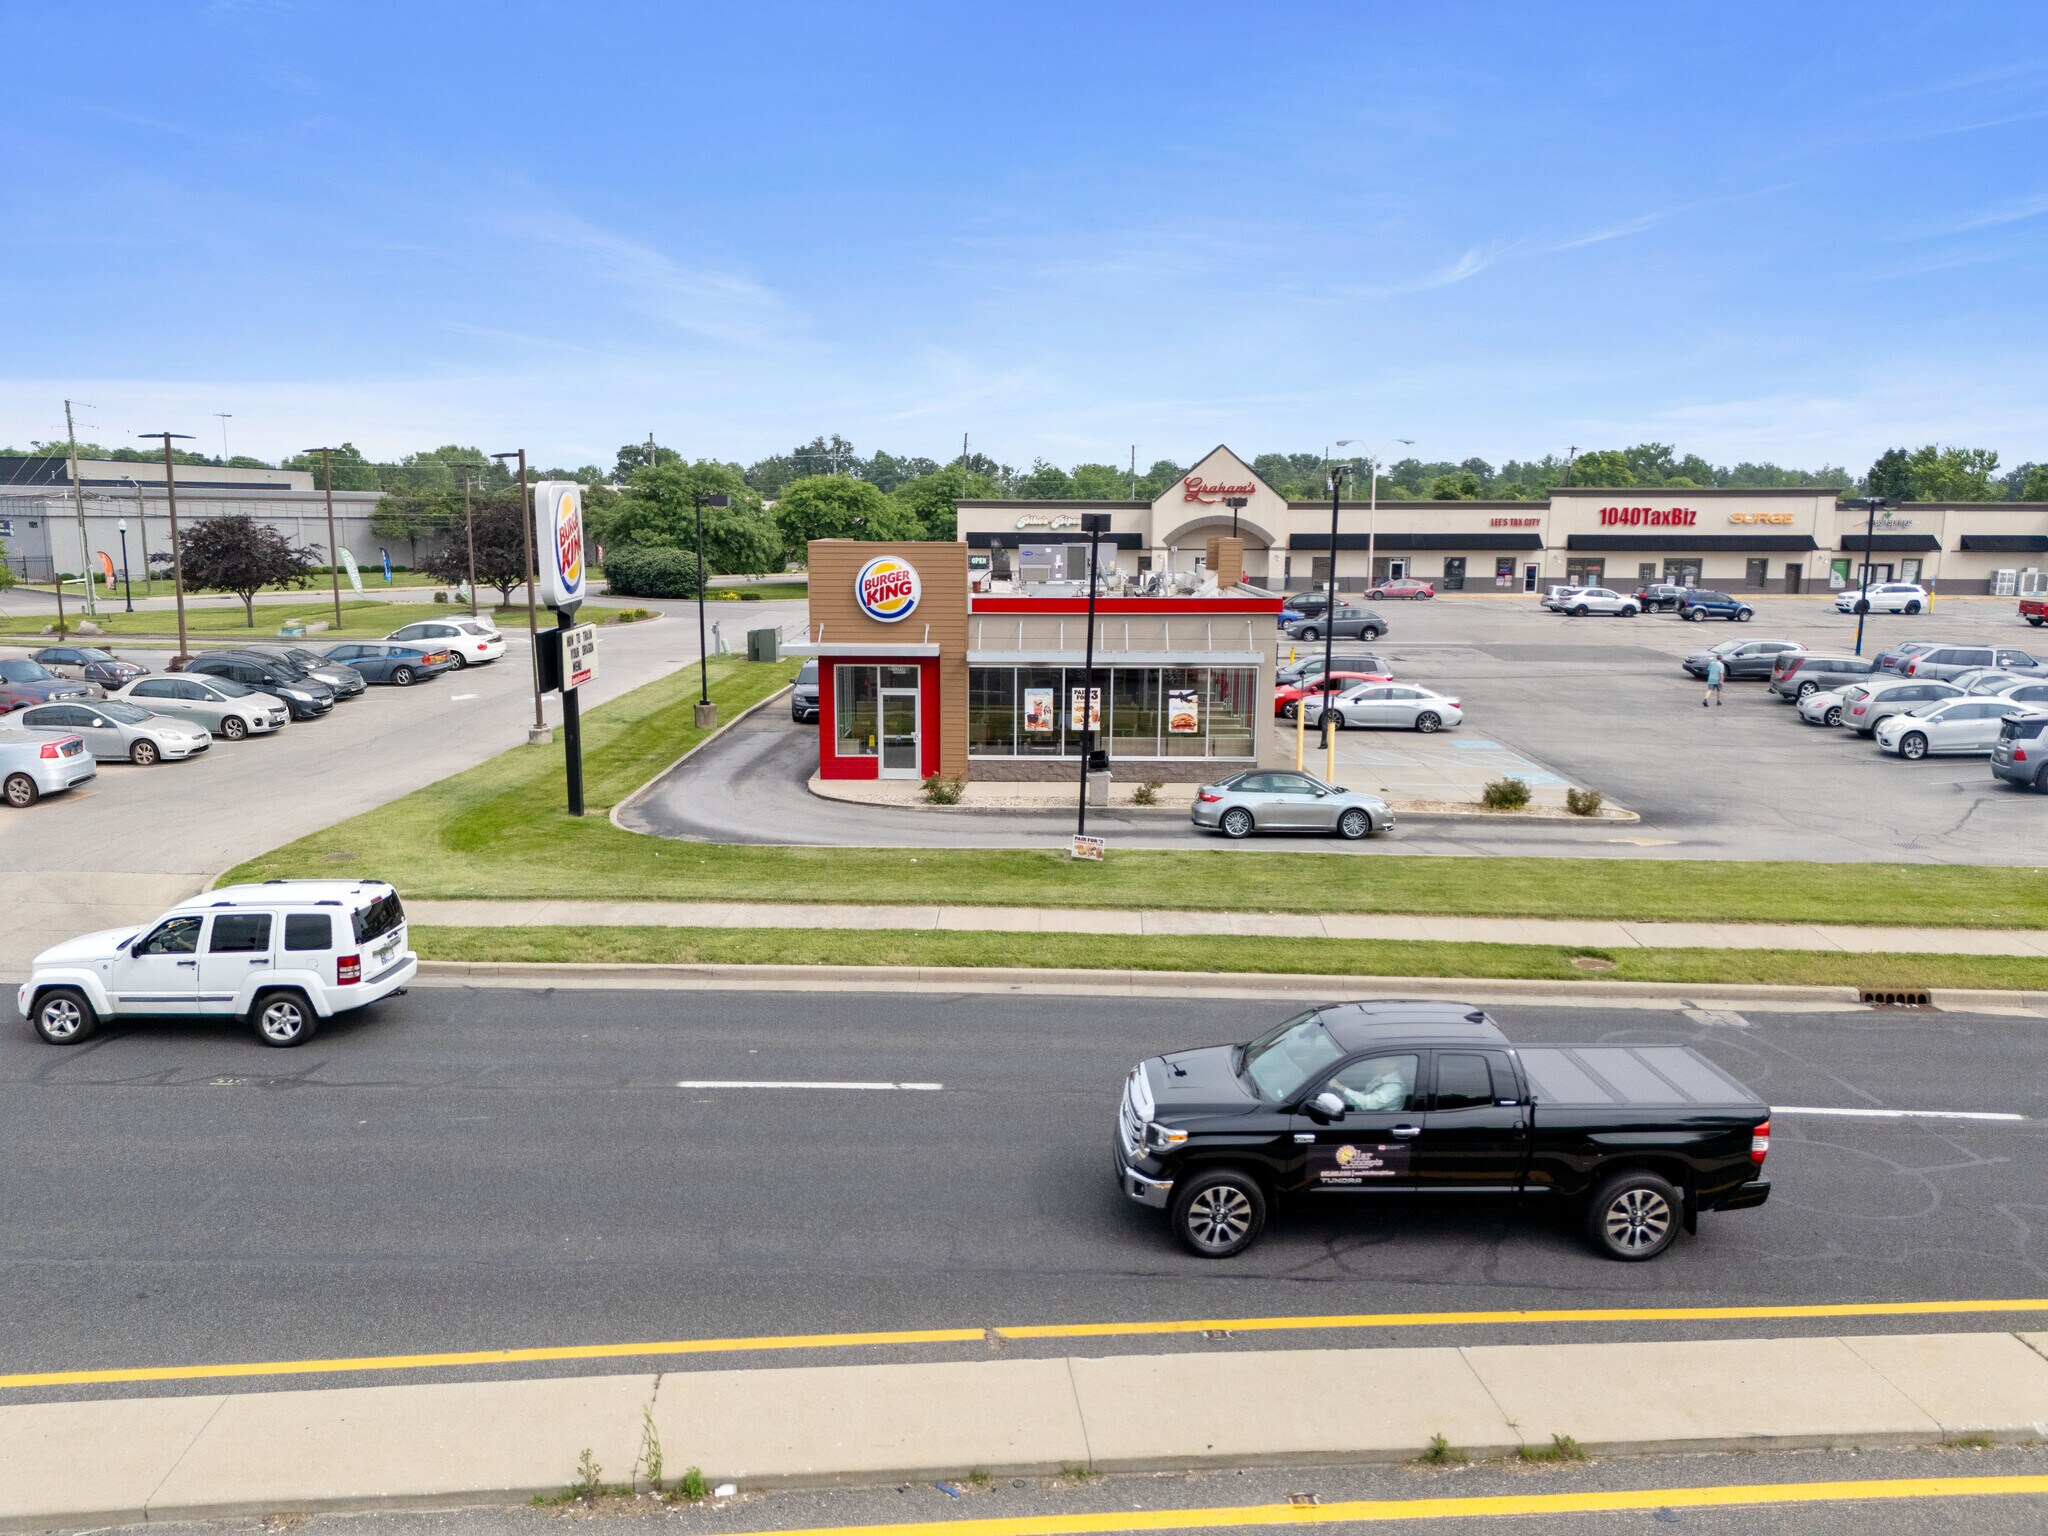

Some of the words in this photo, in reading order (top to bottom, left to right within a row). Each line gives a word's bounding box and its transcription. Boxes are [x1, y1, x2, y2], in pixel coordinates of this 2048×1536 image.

[1184, 477, 1256, 504] Graham's
[1510, 518, 1523, 526] TAX
[1524, 518, 1541, 526] CITY
[1599, 507, 1697, 526] 1040TaxBiz
[1729, 511, 1794, 525] SURGE
[971, 557, 987, 565] OPEN
[864, 570, 910, 591] BURGER
[866, 580, 912, 607] KING
